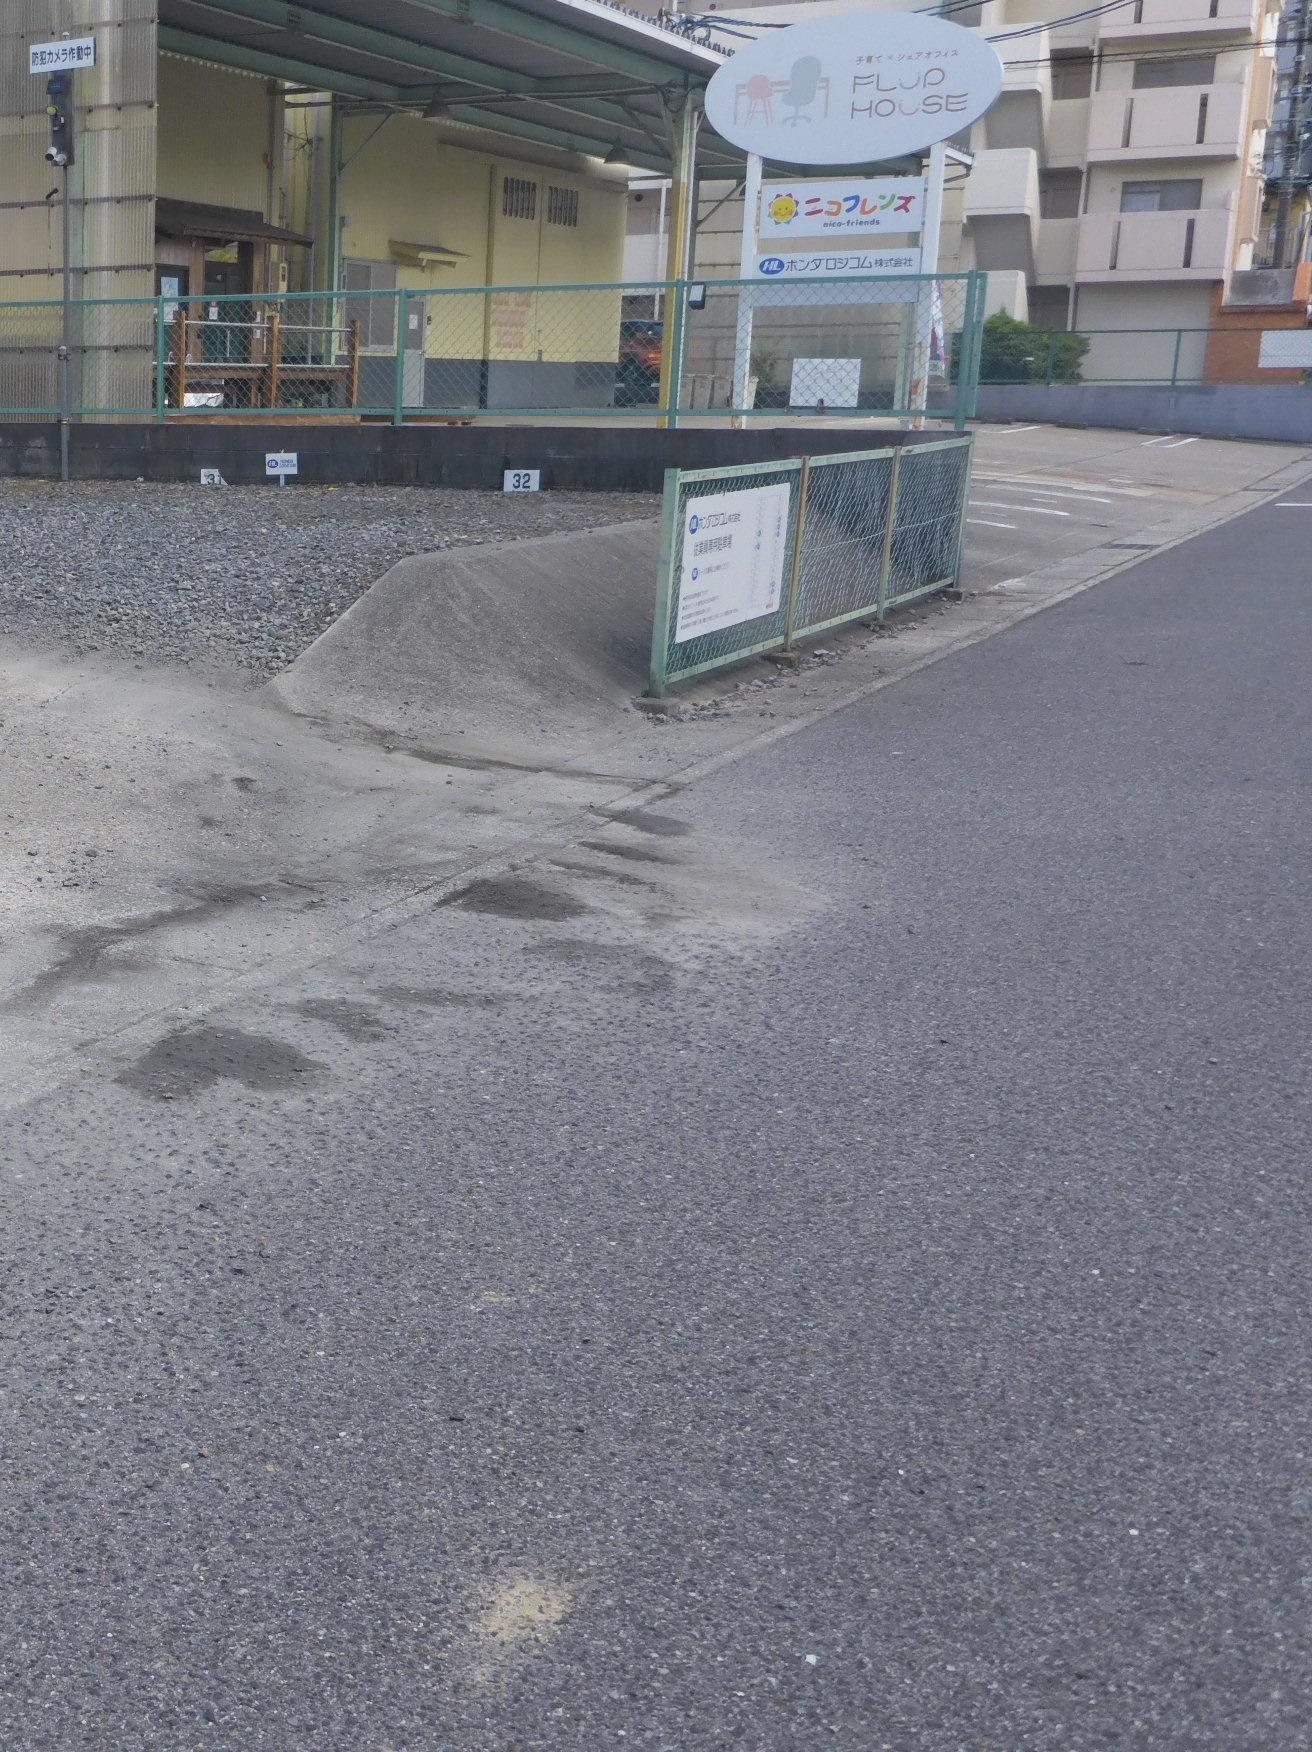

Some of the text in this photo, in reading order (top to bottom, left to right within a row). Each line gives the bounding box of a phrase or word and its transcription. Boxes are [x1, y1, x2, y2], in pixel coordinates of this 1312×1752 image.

[31, 45, 92, 66] 防犯カメラ作動中
[851, 92, 969, 119] HOUSE
[804, 193, 916, 217] ニコフレンズ
[822, 218, 881, 229] nico-friends
[512, 472, 531, 489] 32
